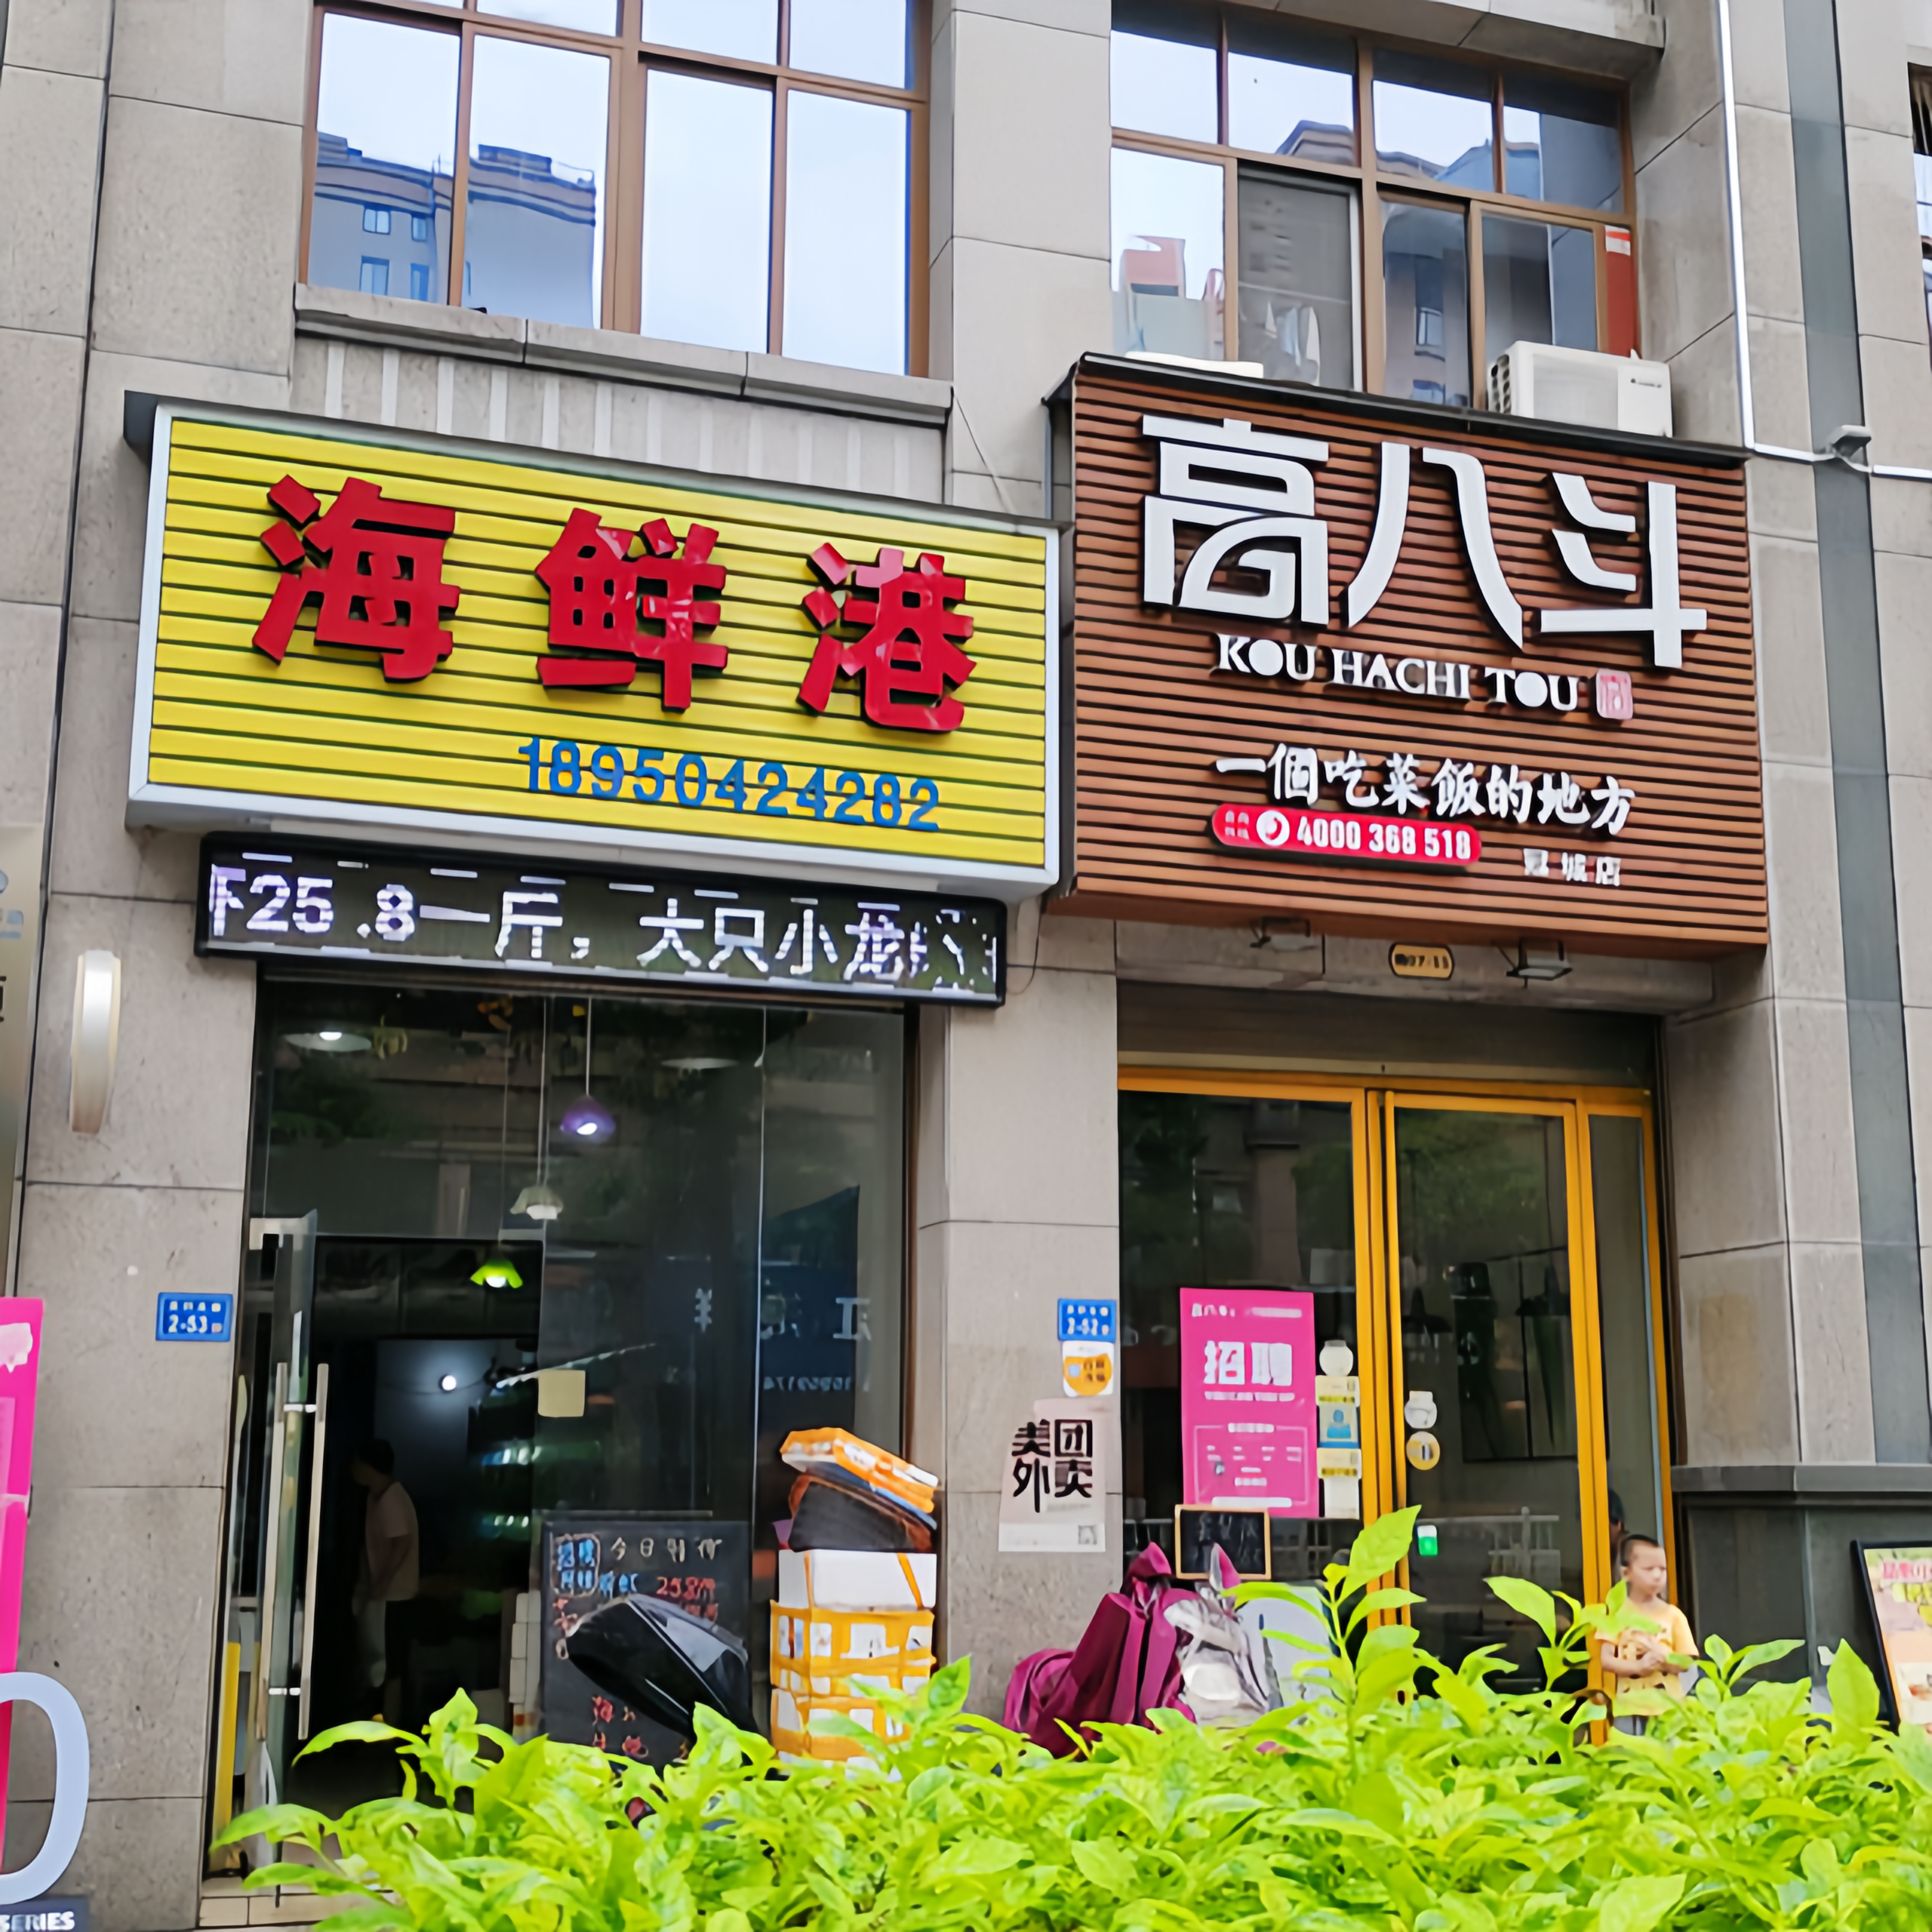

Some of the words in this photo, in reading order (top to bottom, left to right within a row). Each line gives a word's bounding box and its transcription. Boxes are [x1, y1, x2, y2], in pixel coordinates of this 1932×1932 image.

[1142, 414, 1707, 668] 高八斗
[252, 474, 977, 732] 海鲜港
[1216, 633, 1316, 681] KOU
[1331, 648, 1472, 700] HACHI
[1484, 666, 1580, 711] TOU
[518, 736, 940, 832] 18950424282
[1216, 743, 1635, 835] 一個吃菜飯的地方
